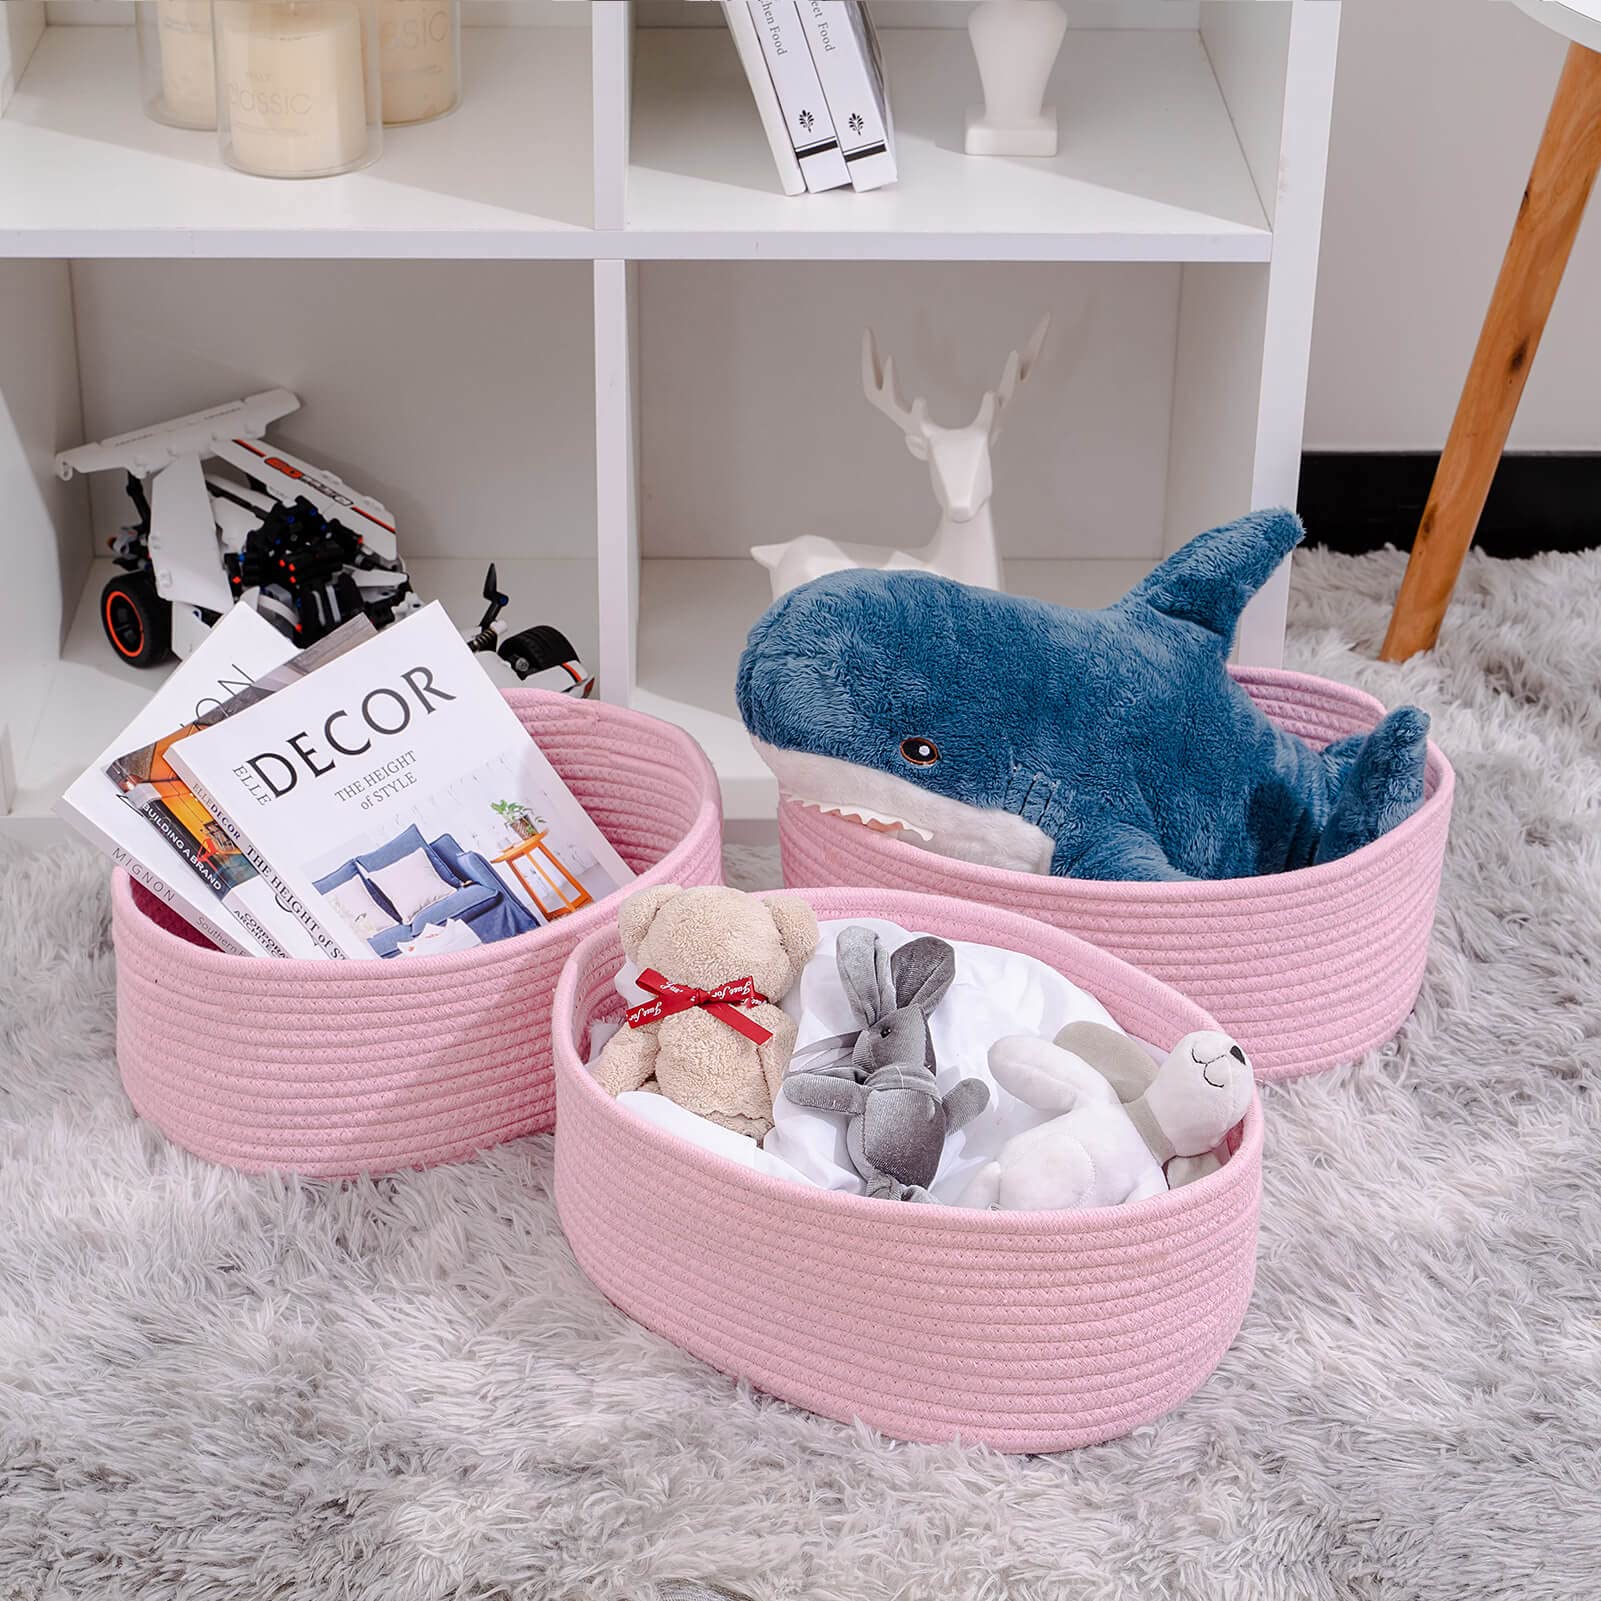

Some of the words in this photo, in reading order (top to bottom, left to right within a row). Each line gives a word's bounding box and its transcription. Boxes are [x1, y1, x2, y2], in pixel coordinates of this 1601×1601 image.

[758, 0, 775, 25] hen
[770, 25, 788, 56] Food
[818, 22, 836, 52] Food
[246, 667, 456, 798] DECOR
[232, 765, 272, 806] ELLE
[334, 780, 367, 802] THE
[365, 750, 417, 788] HEIGHT
[360, 795, 375, 810] of
[374, 771, 418, 803] STYLE
[142, 802, 185, 849] BUILDING
[182, 848, 192, 858] A
[189, 855, 222, 891] BRAND
[112, 847, 175, 901] MIGNON
[196, 916, 238, 954] Southern
[246, 845, 272, 878] THE
[270, 876, 320, 933] HEIGHT
[318, 934, 333, 949] of
[234, 909, 279, 958] ARCHITEC
[244, 913, 289, 959] CORPORA
[641, 1001, 663, 1016] Just
[711, 986, 730, 1000] for
[728, 981, 752, 996] Just
[628, 1008, 645, 1023] for
